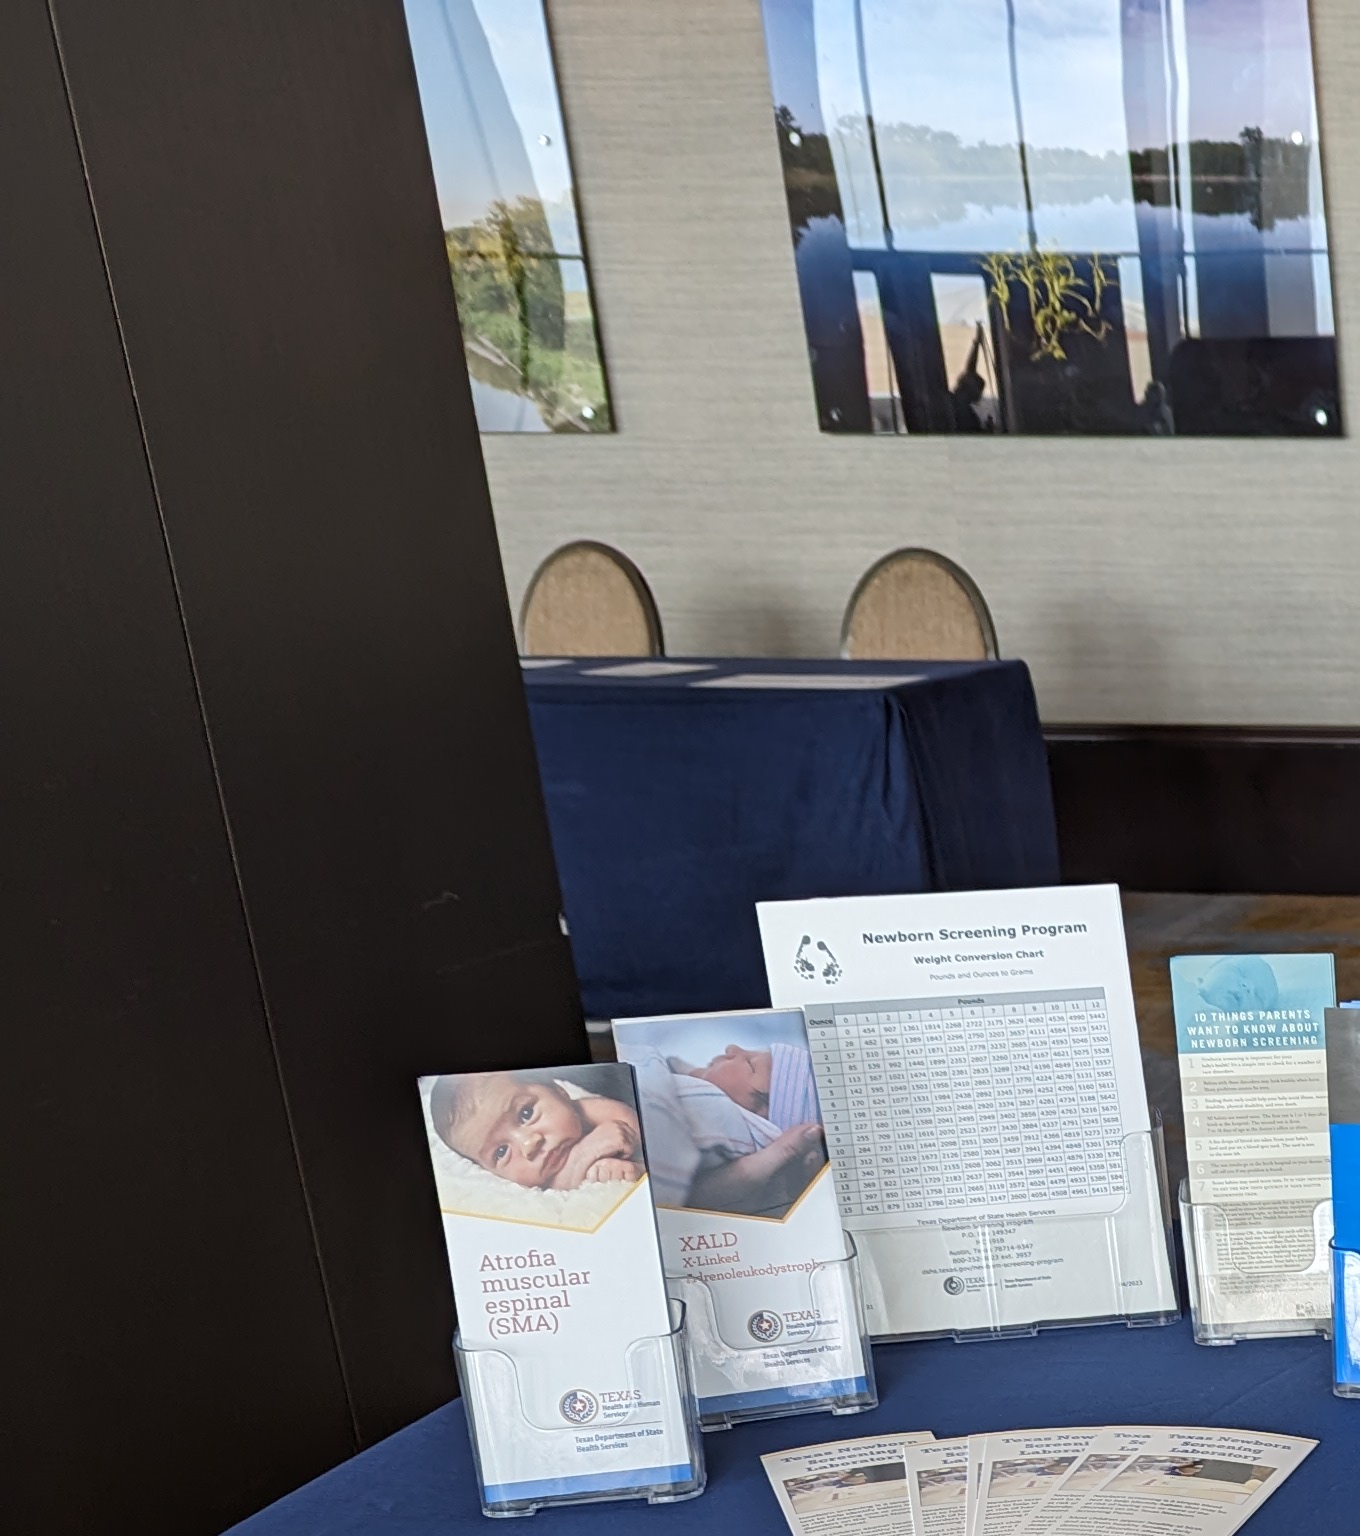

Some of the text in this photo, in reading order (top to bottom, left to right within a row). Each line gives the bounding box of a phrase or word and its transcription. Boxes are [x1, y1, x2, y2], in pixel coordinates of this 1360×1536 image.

[862, 920, 1088, 946] Newborn Screening Program
[914, 948, 1045, 967] Weight Conversion Chart
[929, 967, 1034, 982] Pounds and Ounces to Grams
[1195, 1010, 1311, 1022] 10 THINGS PARENTS
[1187, 1023, 1318, 1036] WANT TO KNOW ABOUT
[1191, 1036, 1318, 1048] NEWBORN SCREENING
[679, 1233, 738, 1252] XALD
[479, 1249, 556, 1272] Atrofia
[682, 1252, 740, 1268] X-Linked
[481, 1269, 590, 1293] muscular
[485, 1290, 571, 1316] espinal
[488, 1312, 559, 1340] (SMA)
[1168, 1433, 1292, 1450] Texas Newborn
[1181, 1441, 1264, 1454] Screening
[781, 1440, 918, 1463] Texas Newborn
[807, 1449, 897, 1465] Screening
[1170, 1448, 1262, 1462] Laboratory
[806, 1454, 904, 1472] Laboratory
